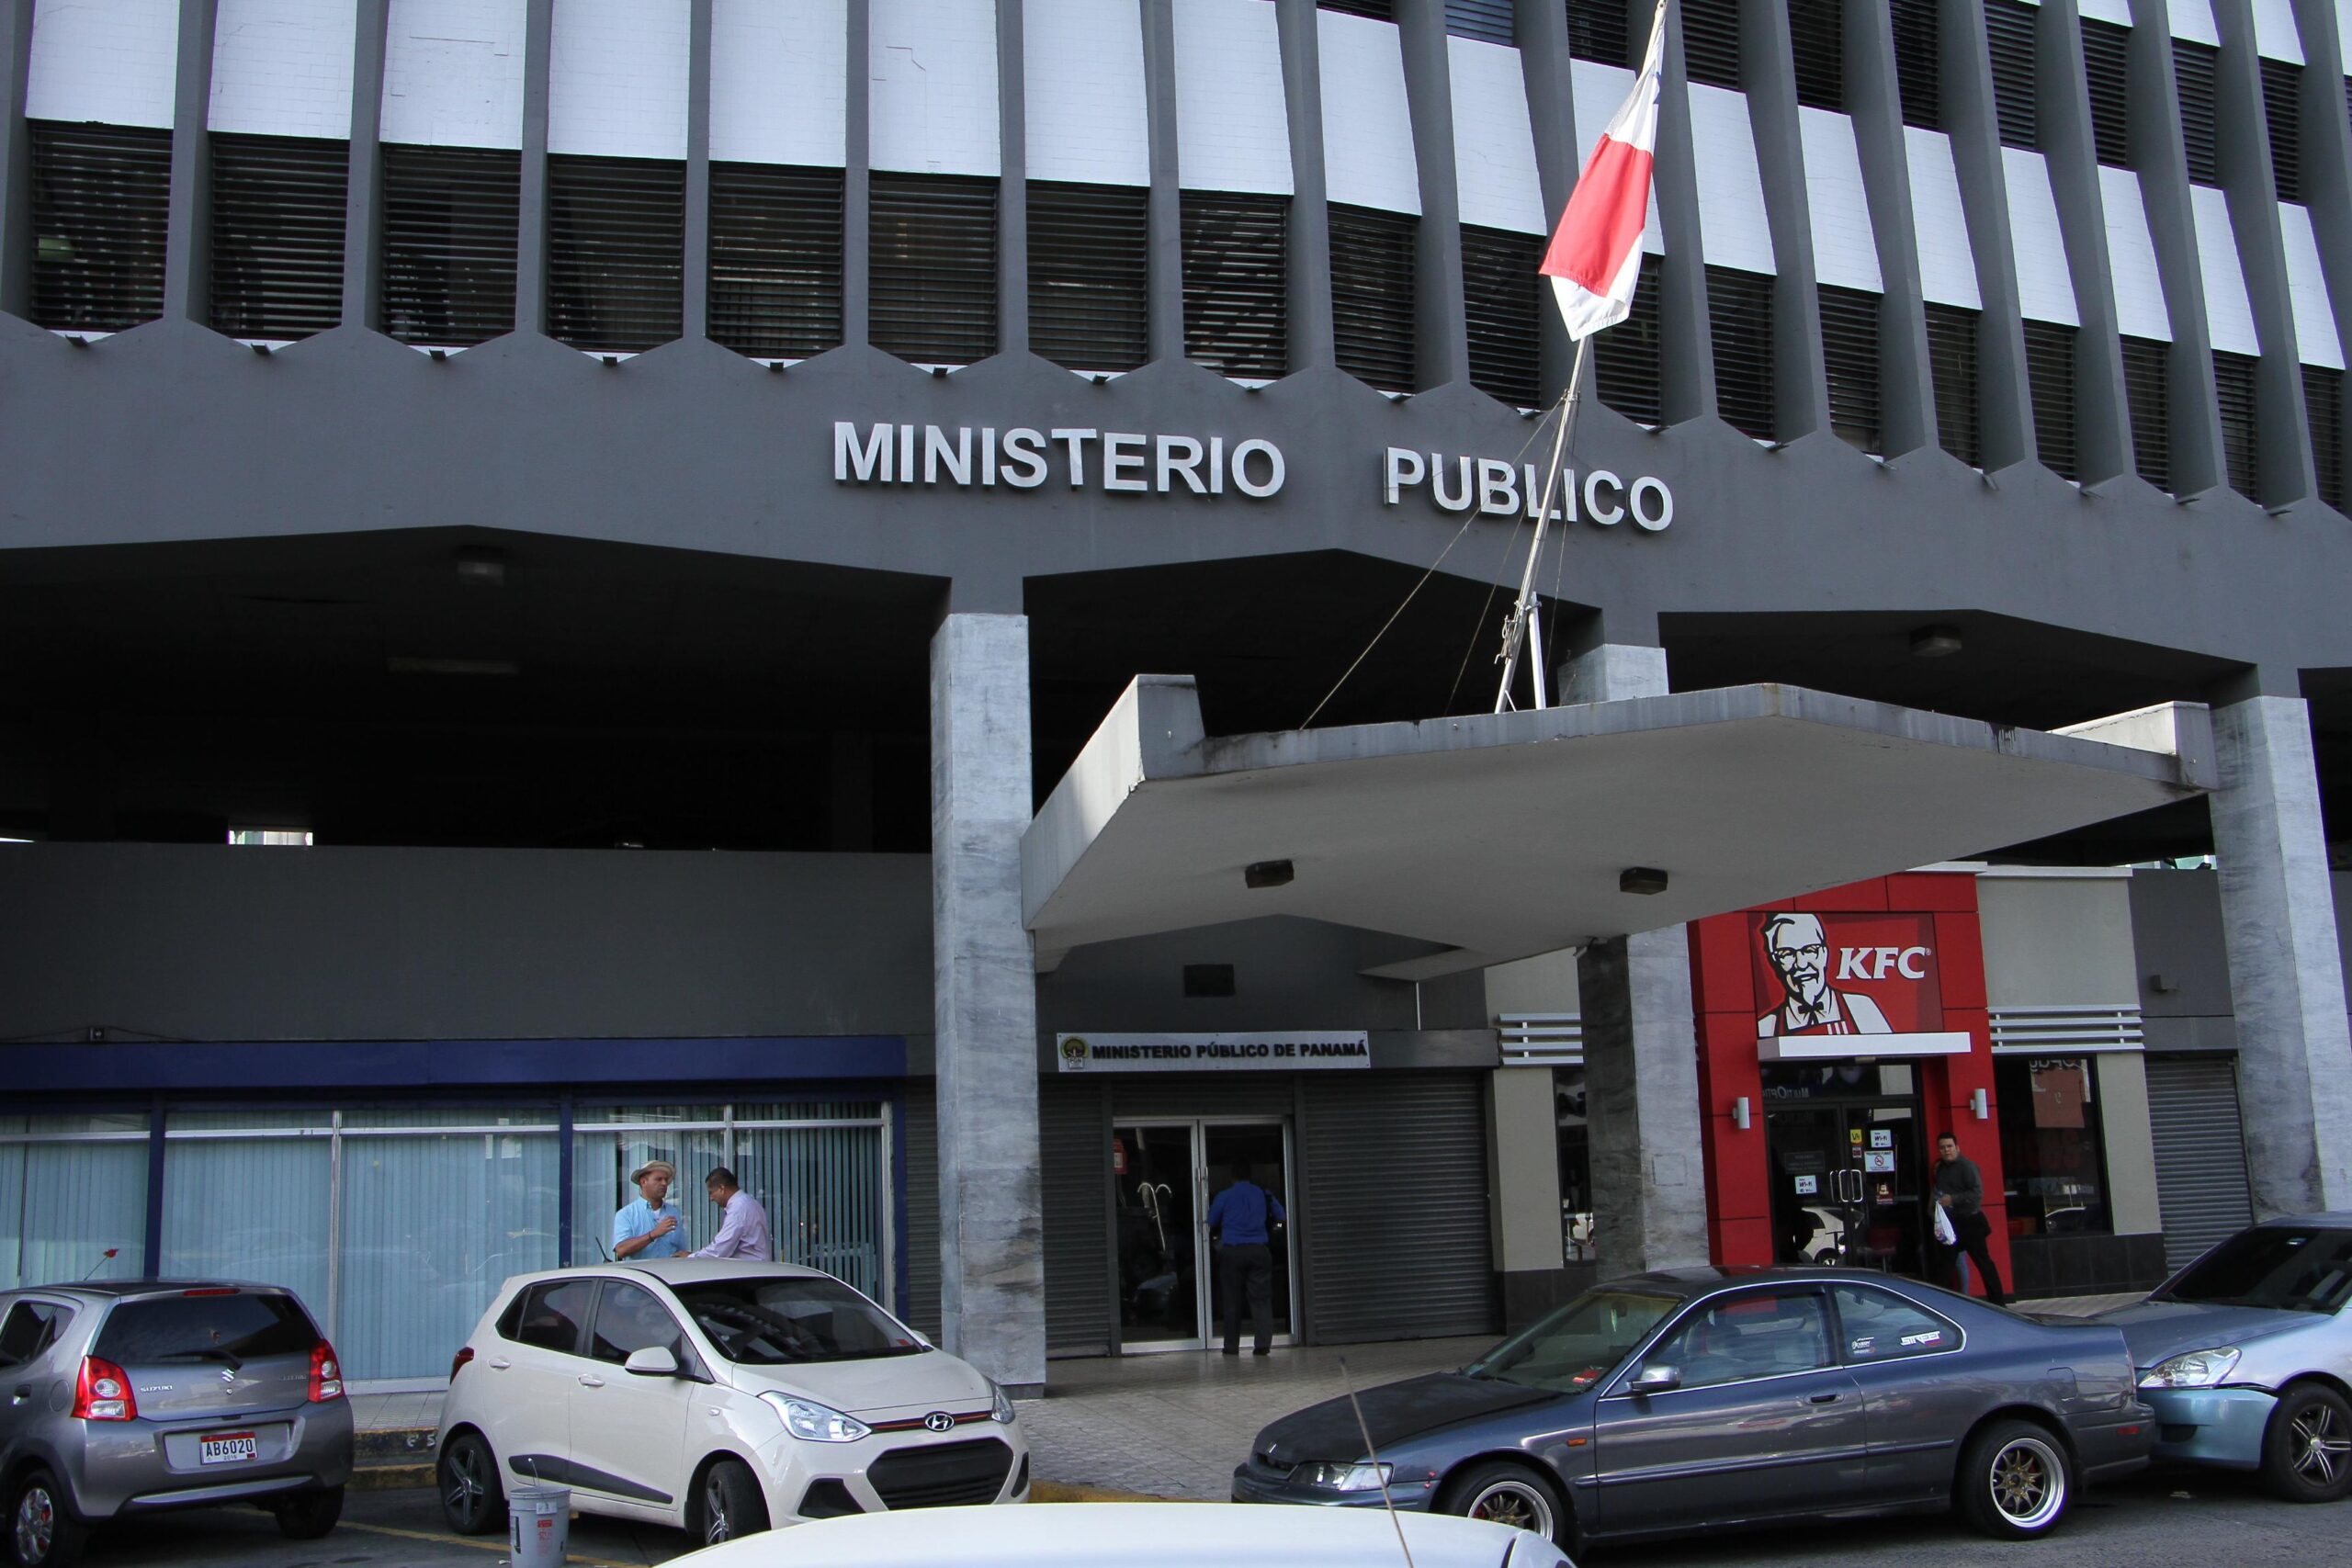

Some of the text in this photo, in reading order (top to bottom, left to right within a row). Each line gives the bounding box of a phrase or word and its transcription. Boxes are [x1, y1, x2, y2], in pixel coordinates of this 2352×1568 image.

[834, 421, 1674, 532] MINISTERIO PUBLICO
[1836, 946, 1926, 980] KFC
[1091, 1039, 1368, 1059] MINISTERIO PÚBLICO DE PANAMÁ
[140, 1384, 174, 1393] SUZUKI
[206, 1438, 254, 1457] AB6020
